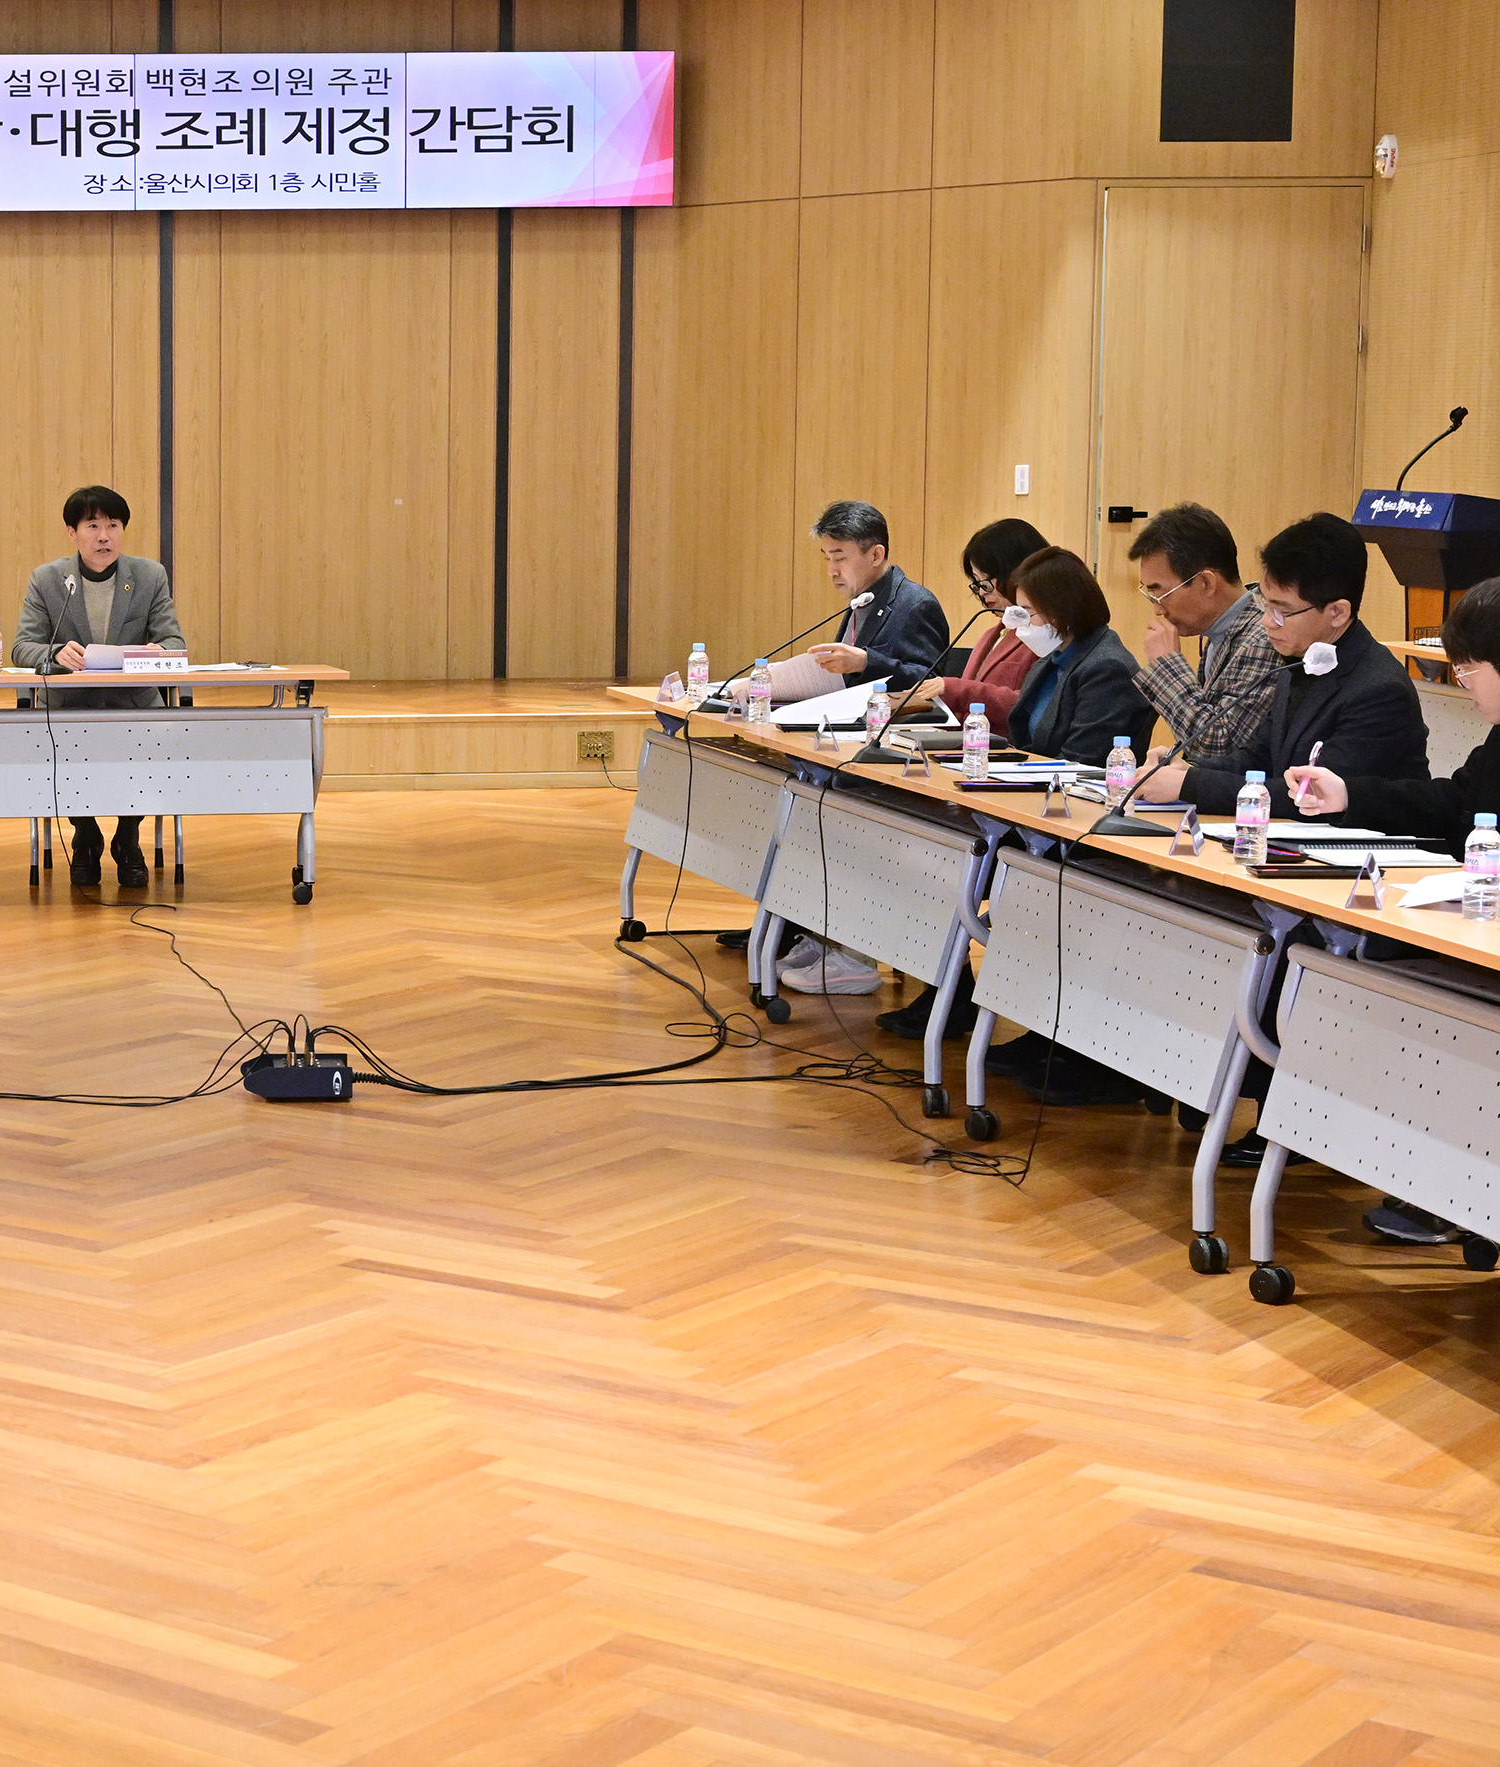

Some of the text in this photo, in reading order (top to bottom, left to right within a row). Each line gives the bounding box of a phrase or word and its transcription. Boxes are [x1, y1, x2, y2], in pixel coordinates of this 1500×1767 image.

[146, 68, 243, 97] 백현조
[250, 67, 314, 97] 의원
[327, 68, 393, 96] 주관
[155, 107, 266, 156] 조례
[281, 106, 390, 156] 제정
[404, 105, 574, 154] 간담회
[268, 173, 305, 194] 1층
[310, 172, 381, 193] 시민홀
